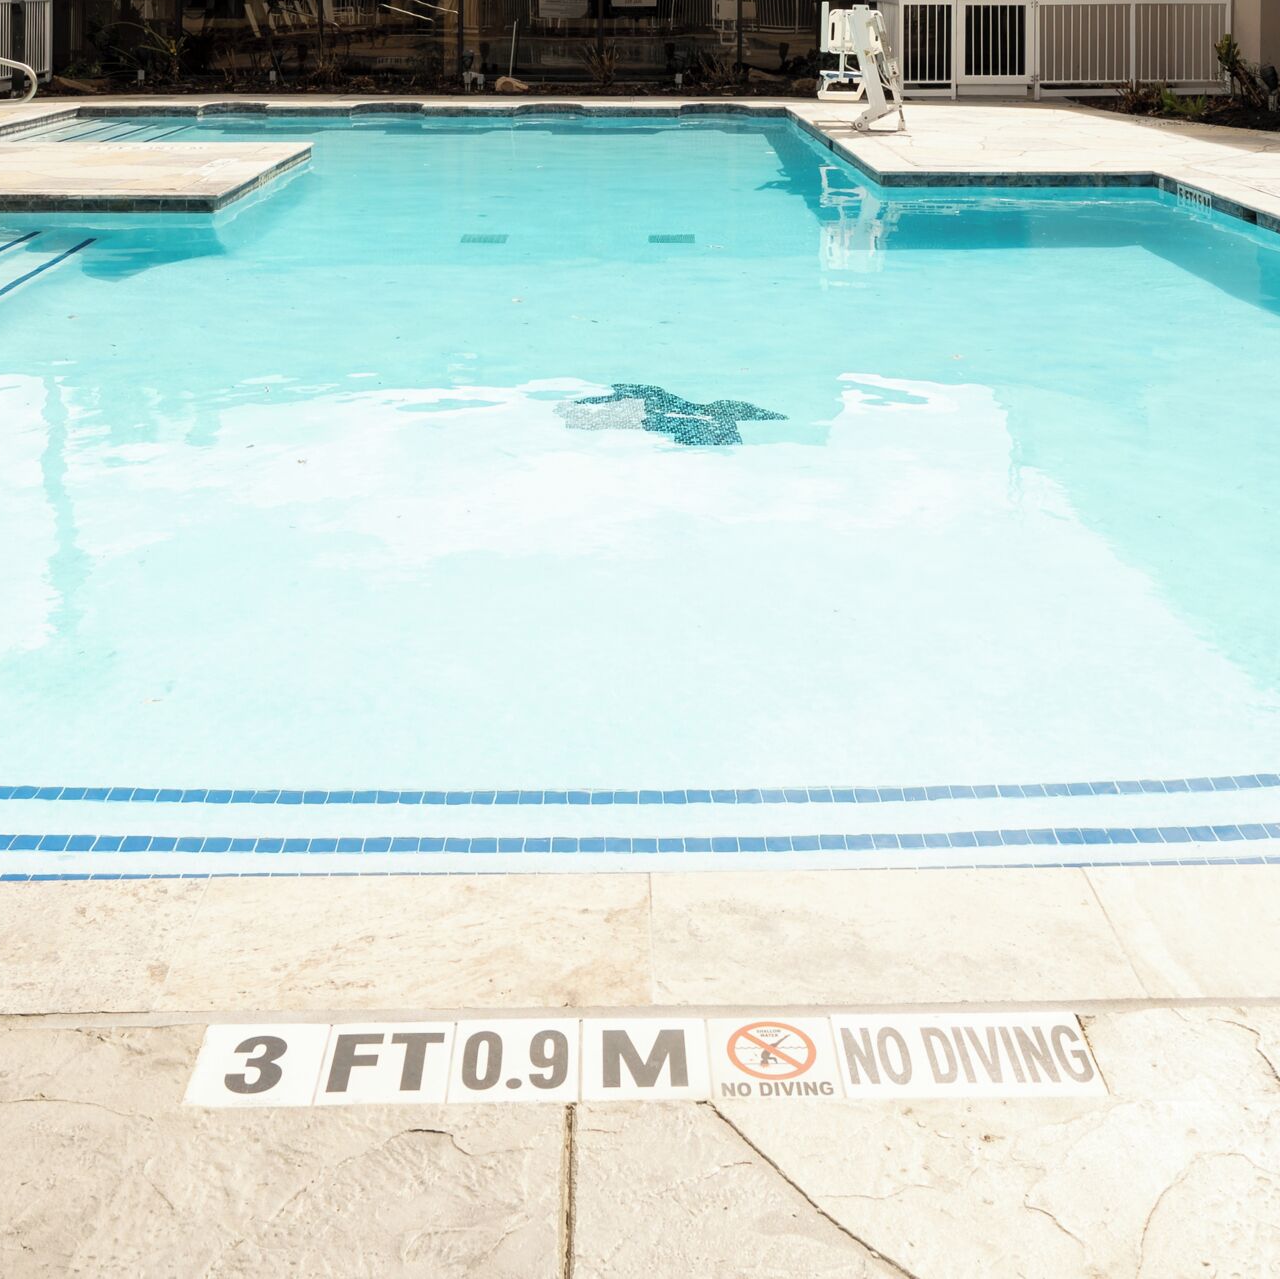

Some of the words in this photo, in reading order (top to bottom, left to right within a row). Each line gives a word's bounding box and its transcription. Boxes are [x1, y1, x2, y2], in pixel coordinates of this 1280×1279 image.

[223, 1035, 288, 1094] 3
[325, 1032, 446, 1092] FT
[461, 1029, 570, 1090] 0.9
[601, 1028, 689, 1088] M
[839, 1026, 913, 1086] NO
[920, 1024, 1095, 1084] DIVING
[721, 1082, 752, 1097] NO
[758, 1081, 835, 1097] DIVING
